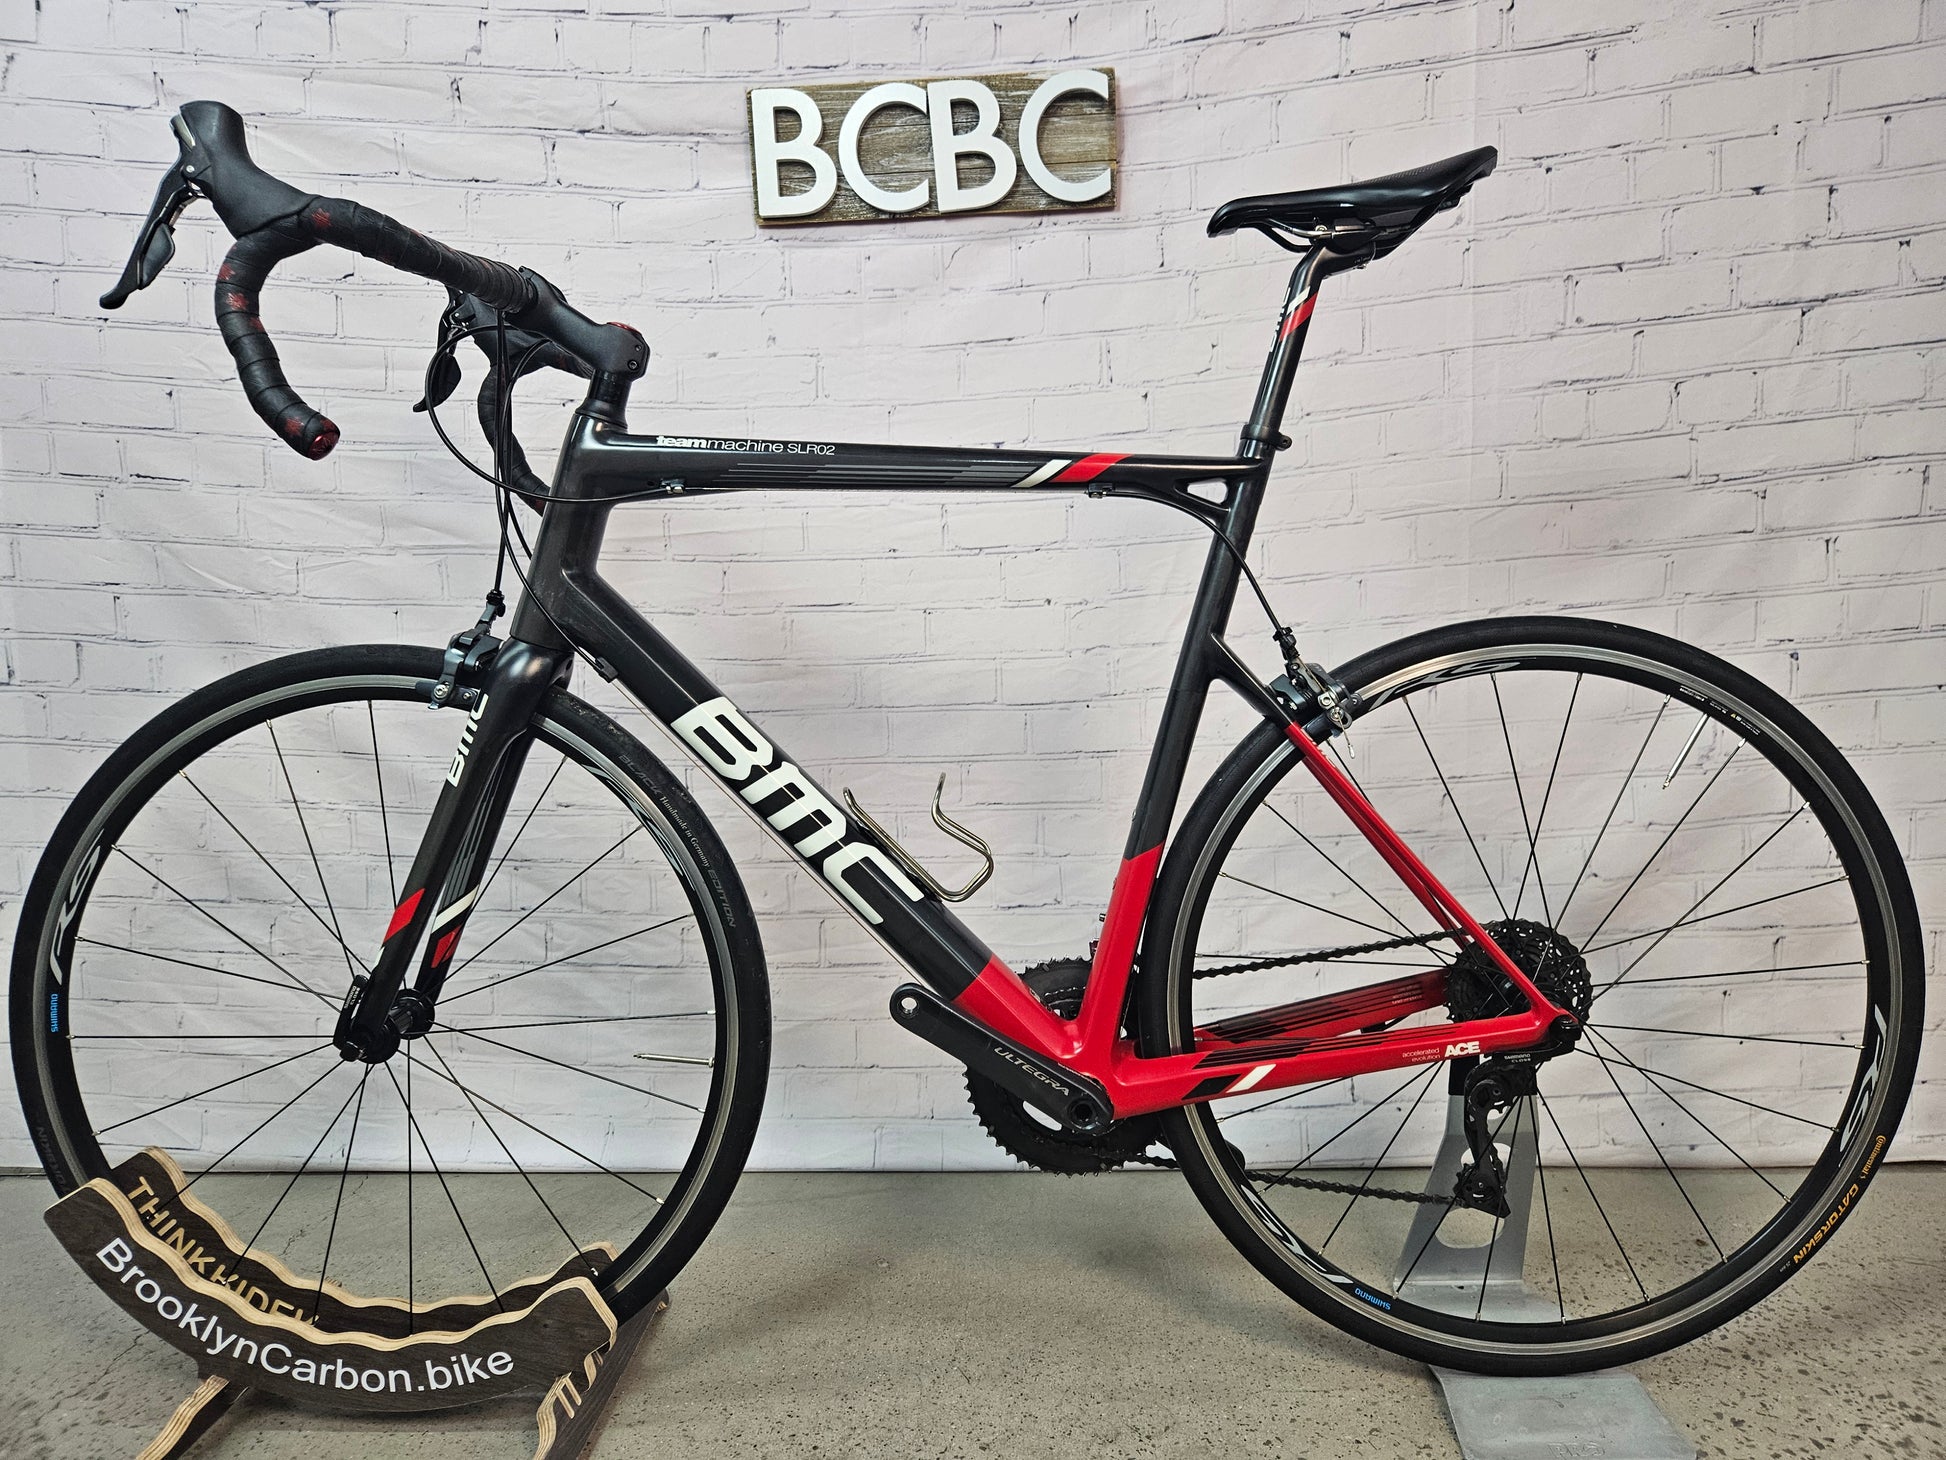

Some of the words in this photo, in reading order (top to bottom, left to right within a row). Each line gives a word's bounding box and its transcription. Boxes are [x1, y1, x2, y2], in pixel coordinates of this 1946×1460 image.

[751, 70, 1112, 219] BCBC
[656, 436, 784, 453] teammachine
[787, 443, 836, 455] SLR02
[670, 696, 925, 925] BMC
[618, 754, 660, 796] BLACK
[658, 795, 688, 832] Handmade
[690, 836, 711, 868] Germany
[707, 868, 737, 928] EDITION
[50, 993, 59, 1033] SHIMANO
[1402, 1047, 1440, 1058] accelerated
[1411, 1054, 1441, 1062] evolution
[1444, 1041, 1480, 1058] ACE
[994, 1046, 1070, 1096] ULTEGRA
[1861, 1135, 1887, 1175] Continental
[1793, 1183, 1860, 1265] GATORSKIN
[96, 1237, 514, 1393] BrooklynCarbon.bike
[1354, 1287, 1392, 1311] SHIMANO
